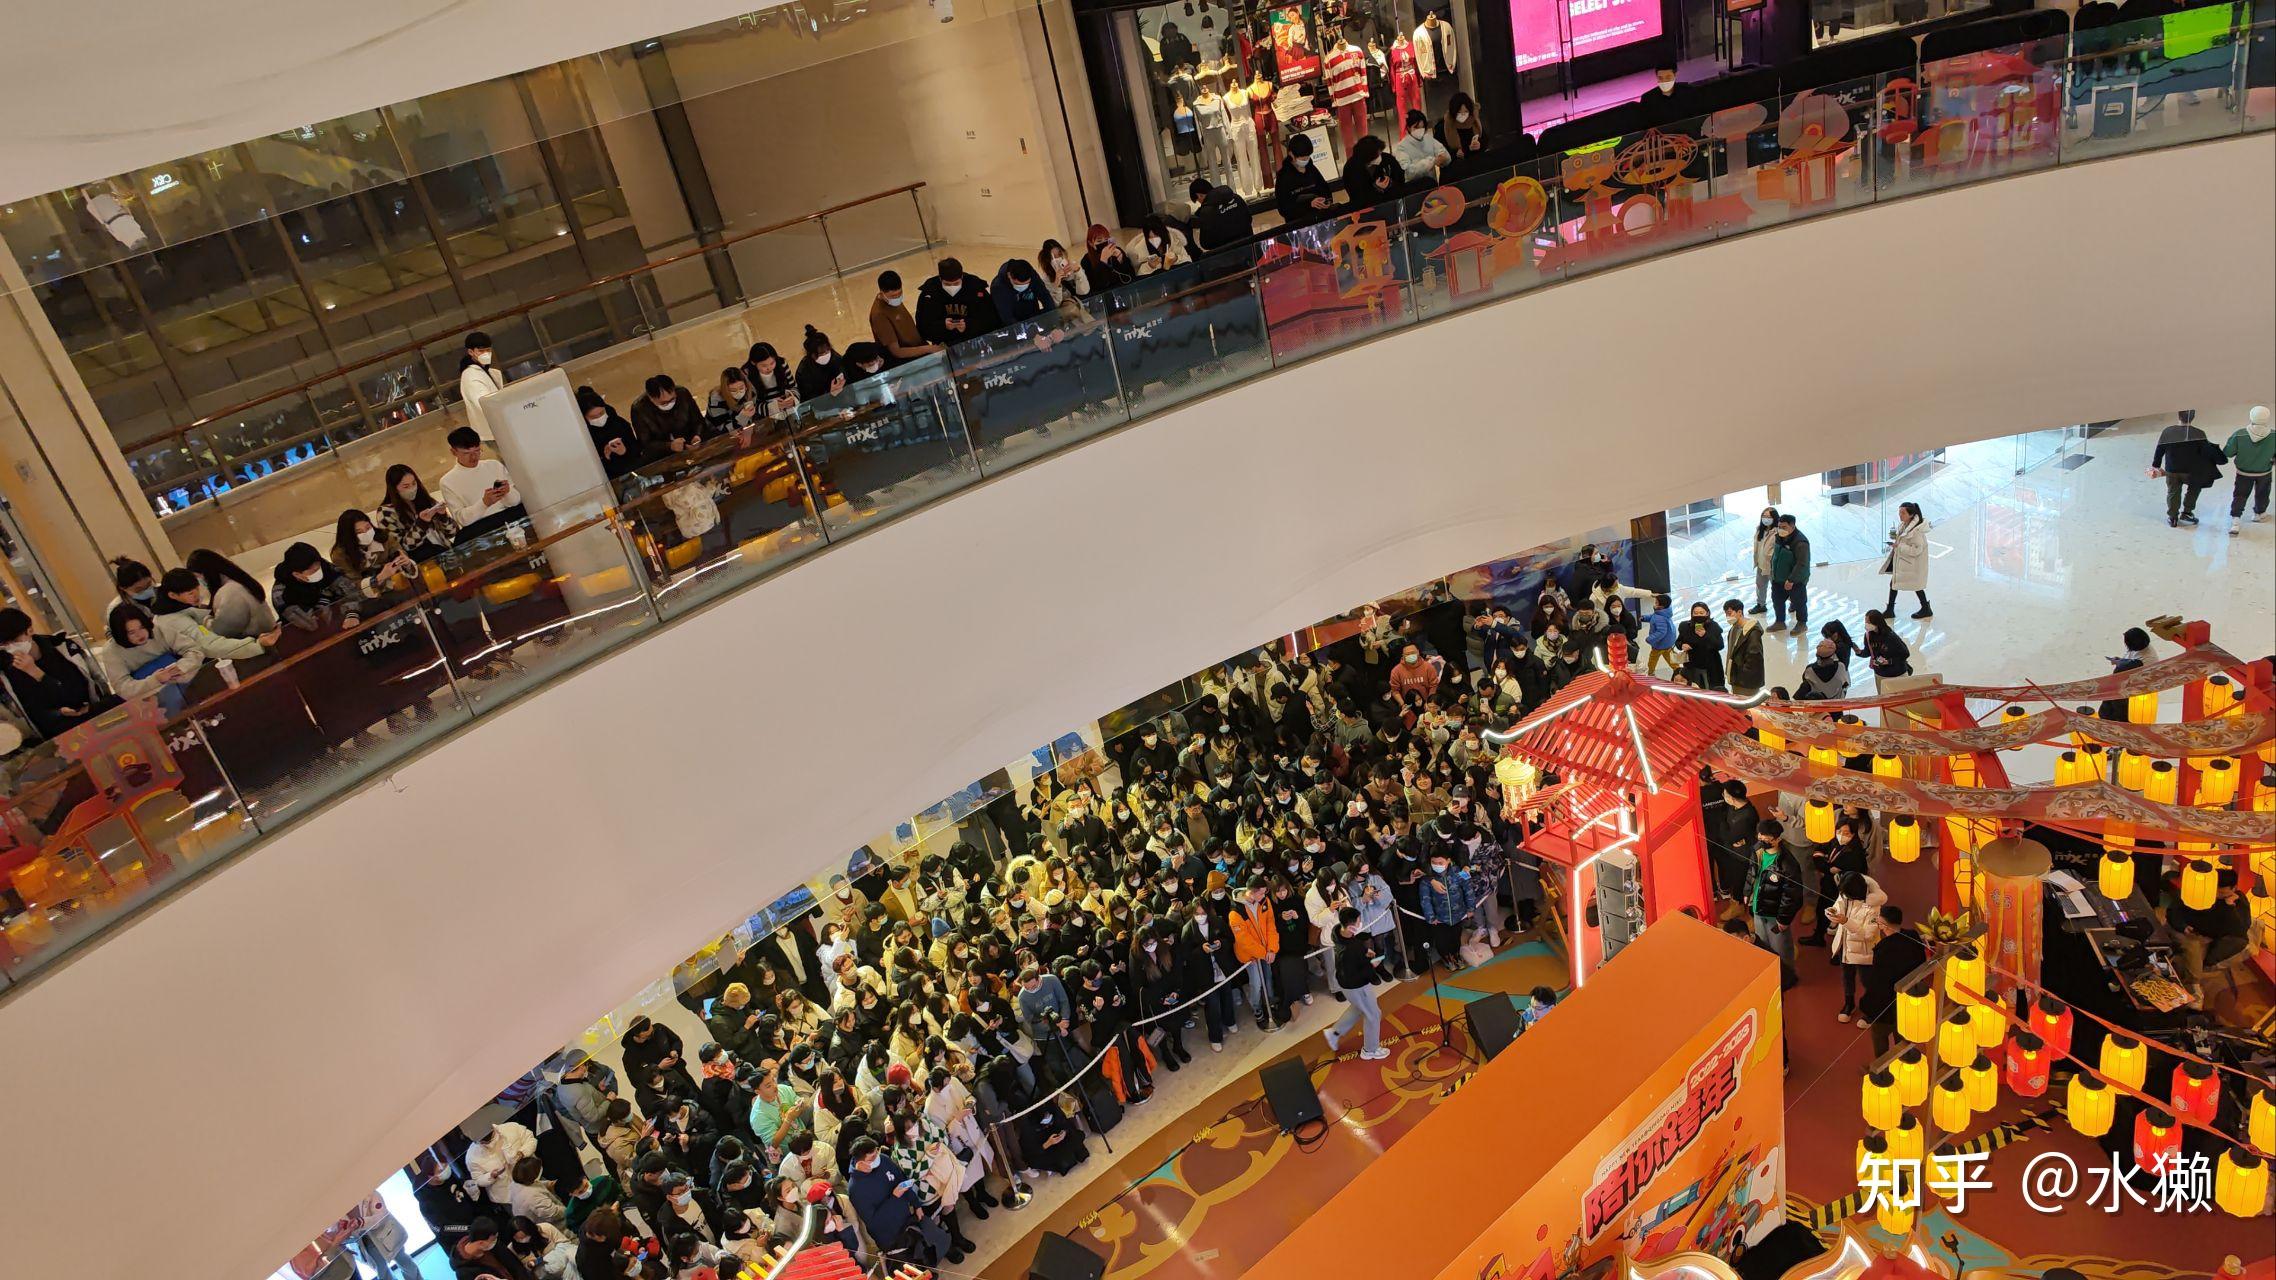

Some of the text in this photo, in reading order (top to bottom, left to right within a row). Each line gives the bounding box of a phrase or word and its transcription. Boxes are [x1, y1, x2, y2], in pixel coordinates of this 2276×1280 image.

[1690, 1023, 1750, 1089] 2022-2023
[1585, 1057, 1738, 1240] 陪你跨年
